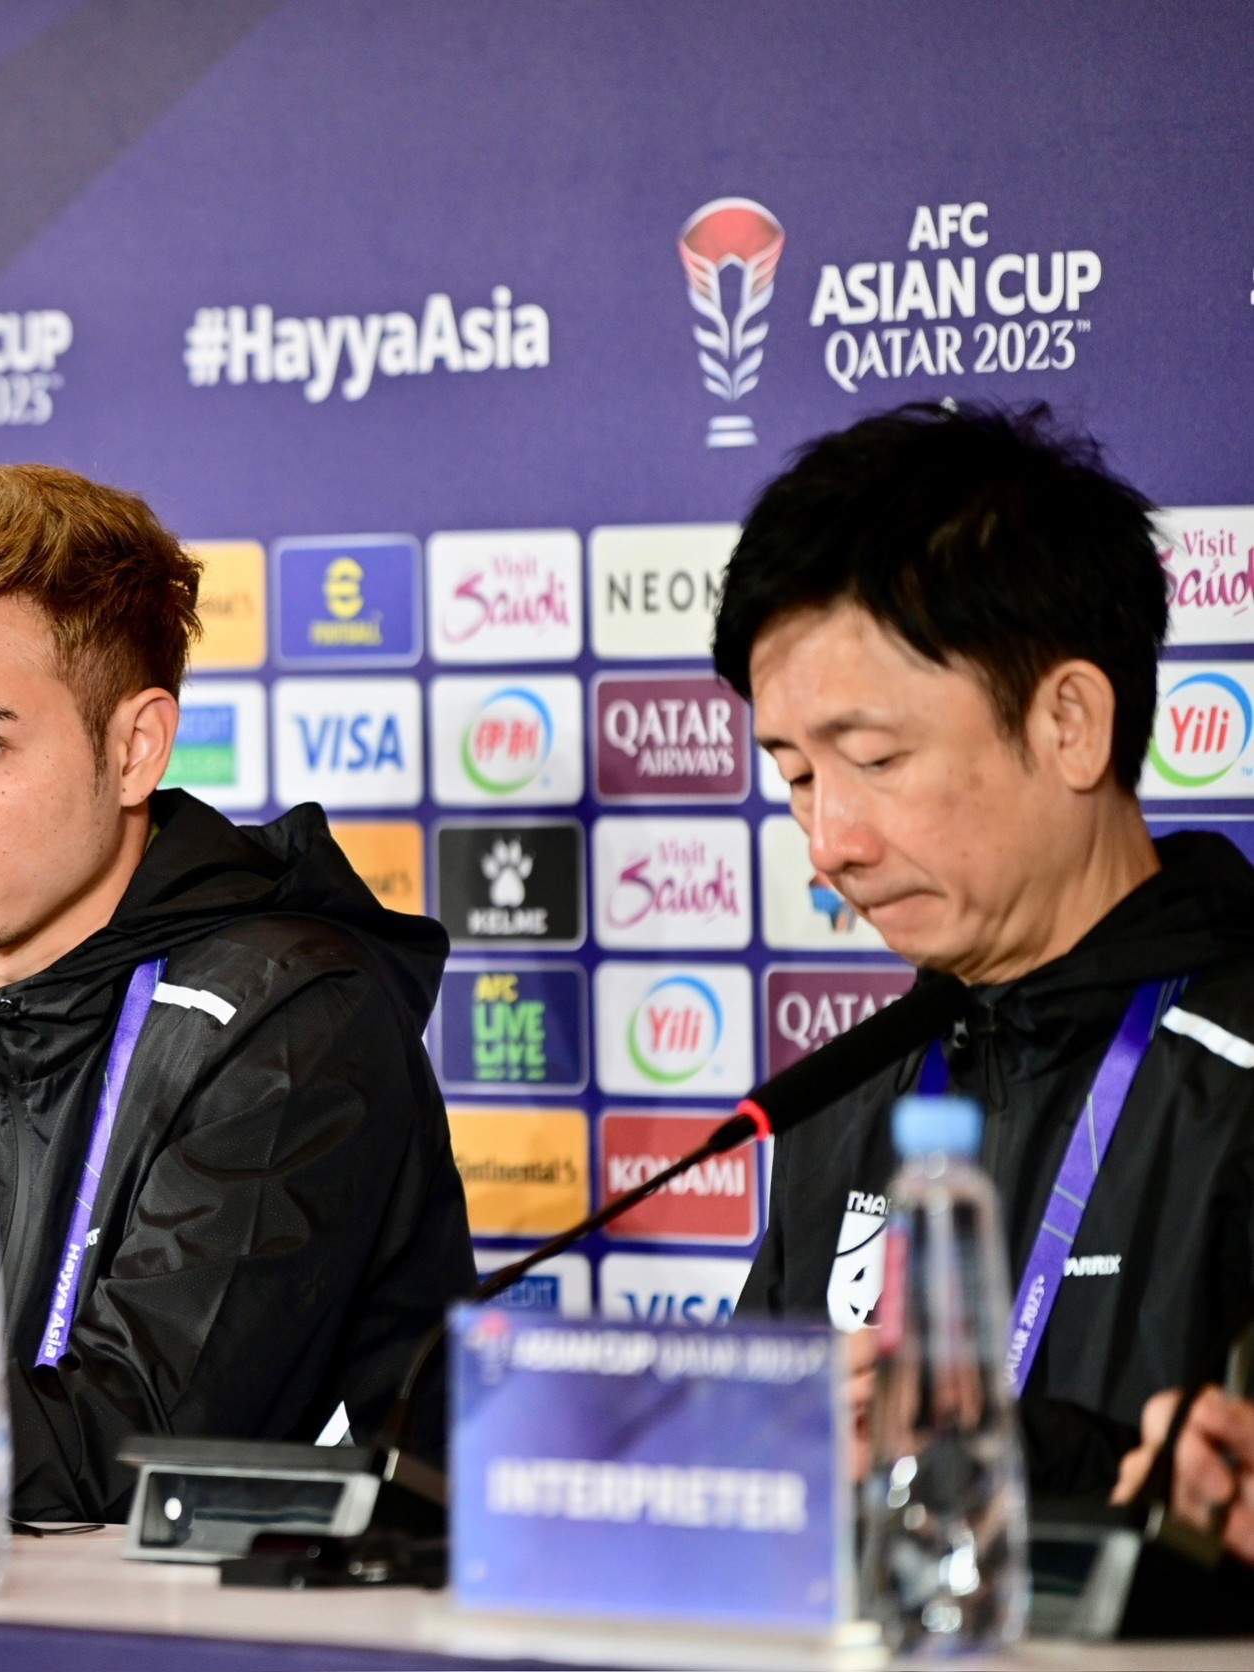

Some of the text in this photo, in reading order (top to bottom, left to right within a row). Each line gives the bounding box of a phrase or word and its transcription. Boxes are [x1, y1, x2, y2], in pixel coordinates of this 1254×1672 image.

[908, 201, 989, 251] AFC
[810, 249, 1103, 327] ASIAN CUP
[183, 284, 550, 404] #HayyaAsia
[824, 326, 965, 393] QATAR
[493, 556, 538, 580] Visit
[1183, 529, 1237, 558] Visit
[444, 570, 571, 645] Saudi
[295, 714, 404, 772] VISA
[603, 698, 734, 757] QATAR
[1170, 705, 1231, 755] Yili
[638, 746, 736, 777] AIRWAYS
[658, 841, 706, 867] Visit
[467, 909, 548, 936] KELME
[606, 857, 741, 930] Saudi
[646, 1005, 704, 1054] Yili
[45, 1243, 81, 1358] Hayya Asia
[487, 1457, 808, 1534] INTERPRETER
